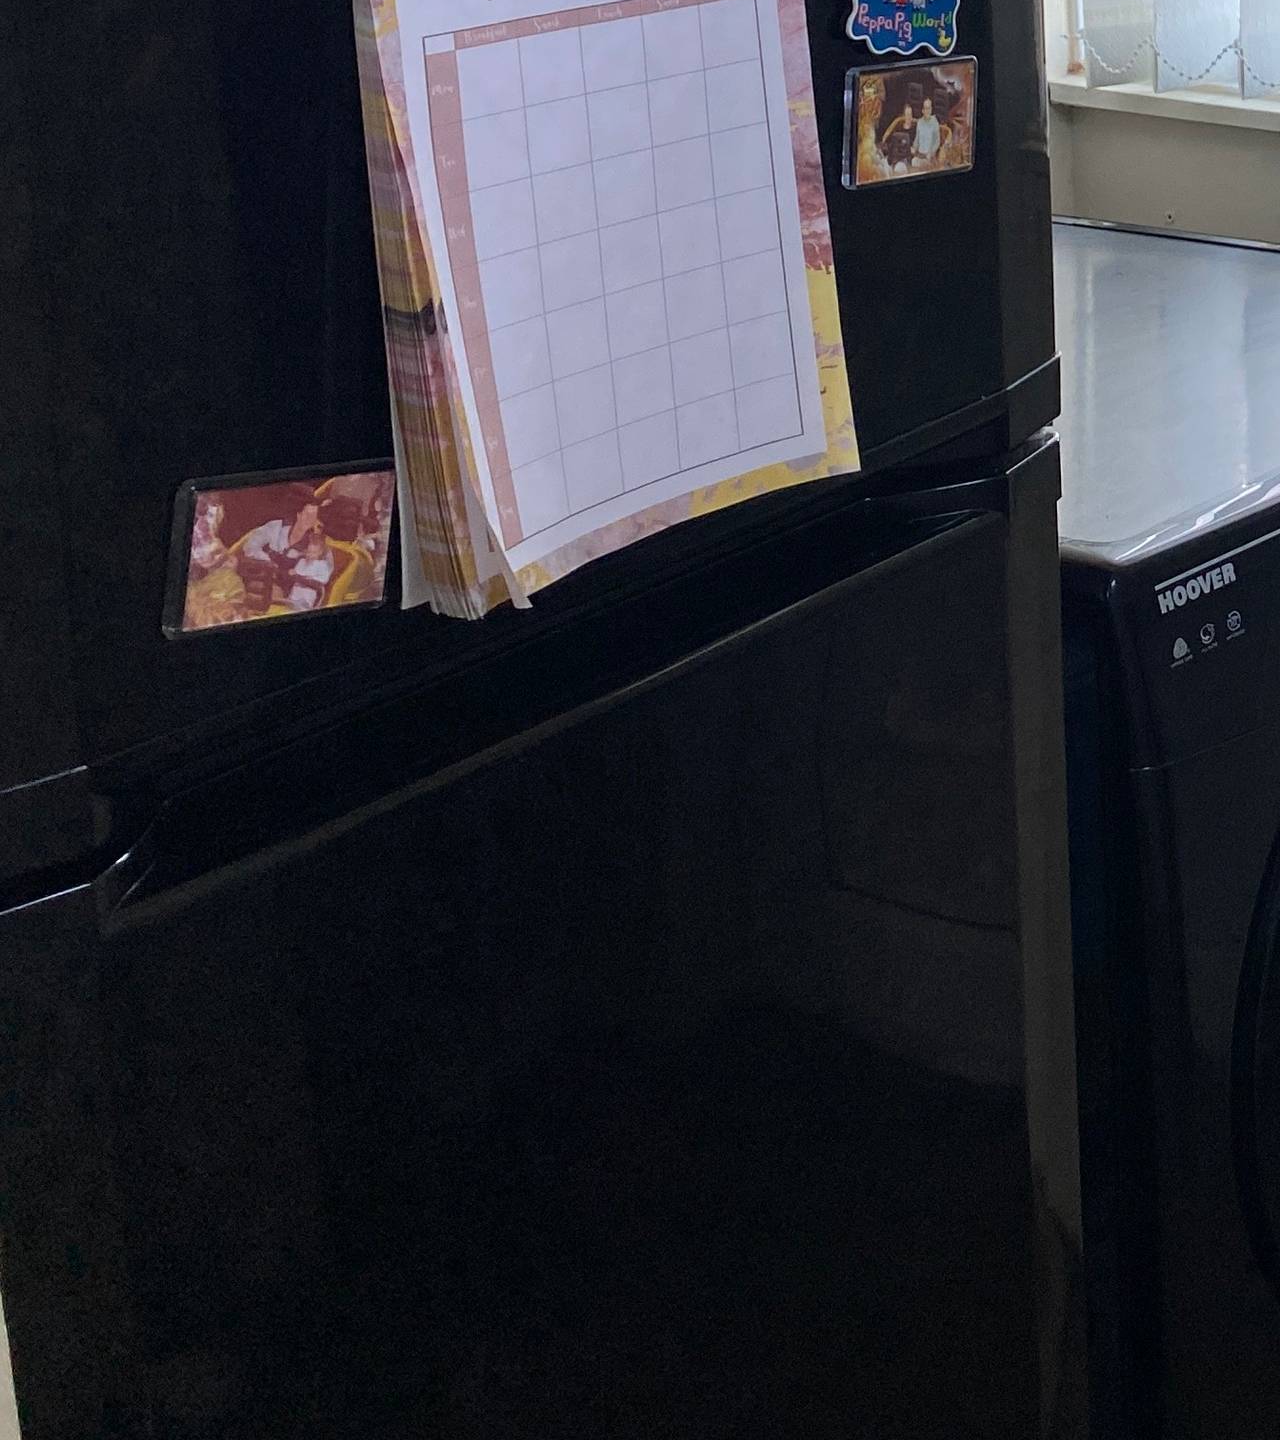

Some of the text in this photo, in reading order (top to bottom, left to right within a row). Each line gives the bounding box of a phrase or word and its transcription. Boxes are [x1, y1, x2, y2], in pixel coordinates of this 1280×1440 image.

[858, 3, 952, 42] Peppa Pig World
[1157, 562, 1237, 614] HOOVER
